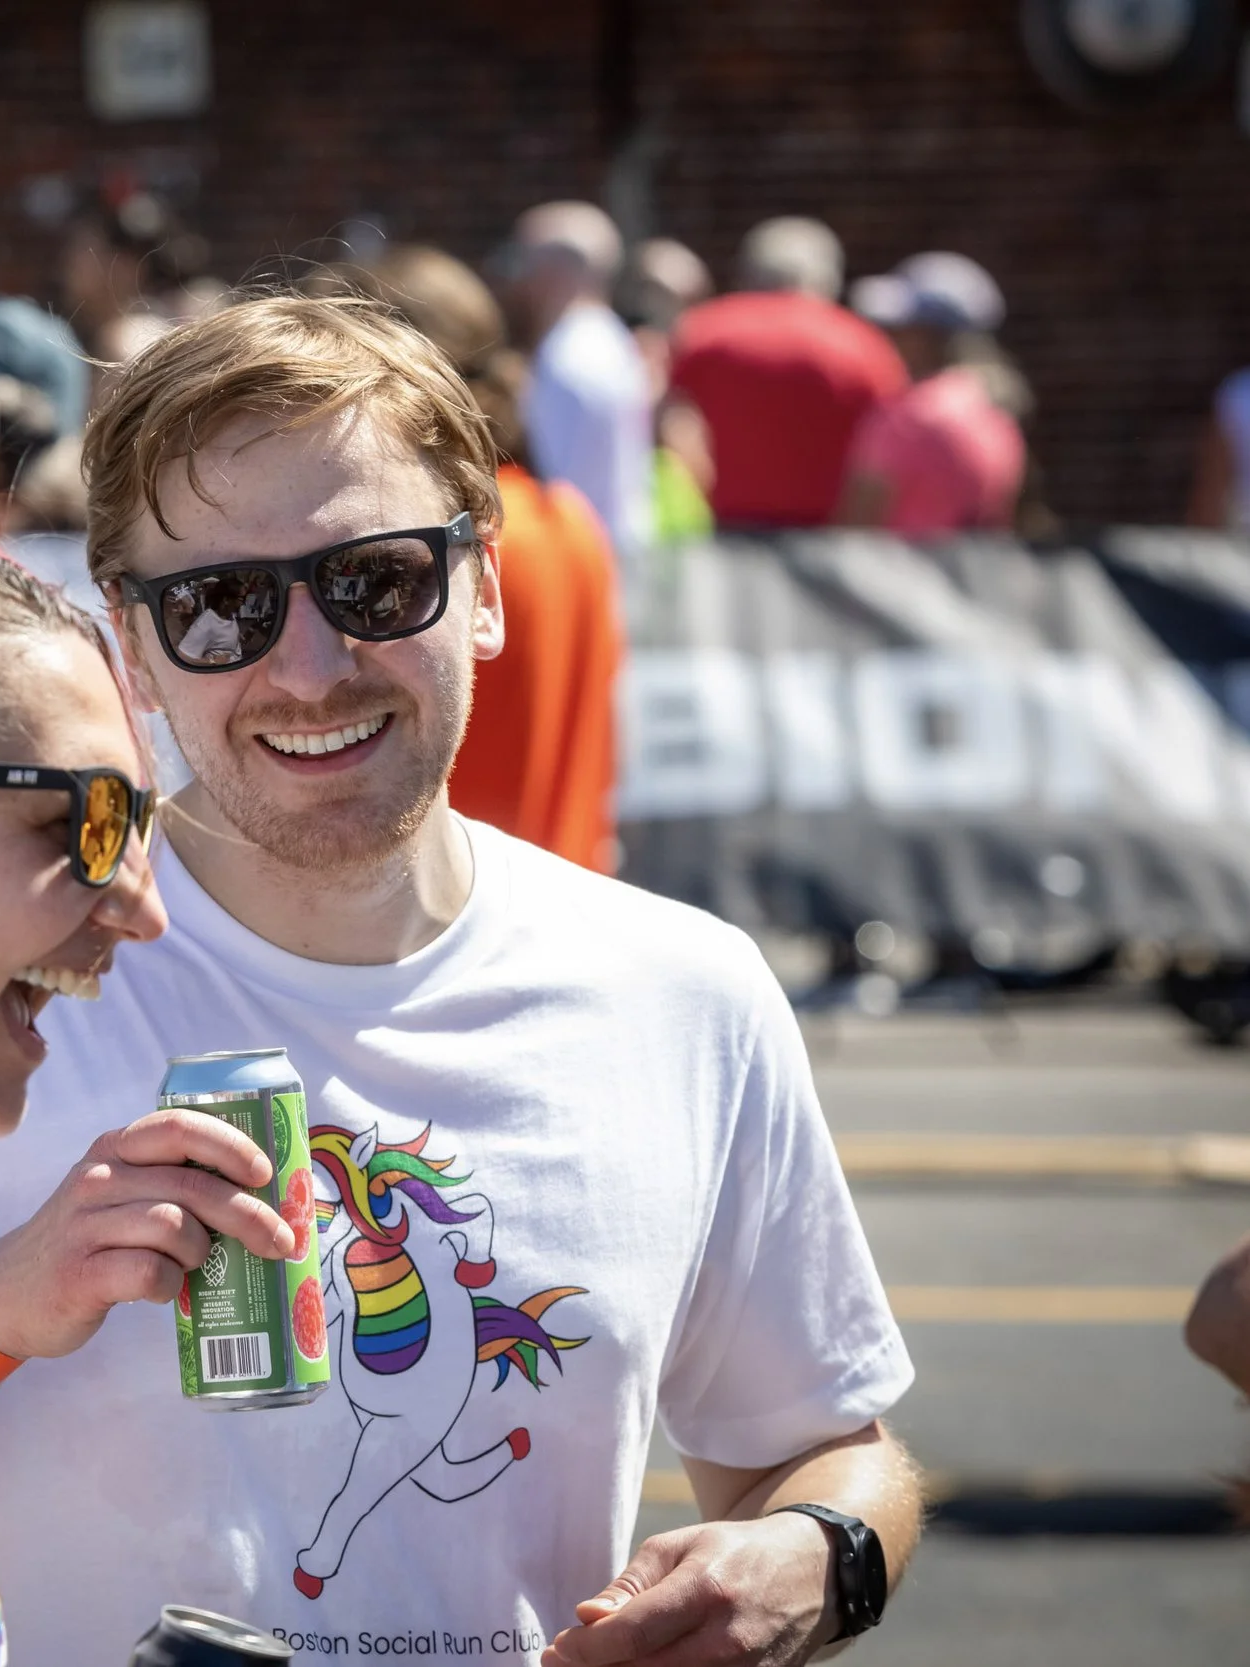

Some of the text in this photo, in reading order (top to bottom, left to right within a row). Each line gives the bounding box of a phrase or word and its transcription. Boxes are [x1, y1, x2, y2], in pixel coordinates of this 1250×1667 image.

[272, 1627, 541, 1655] Boston Social Run Club
